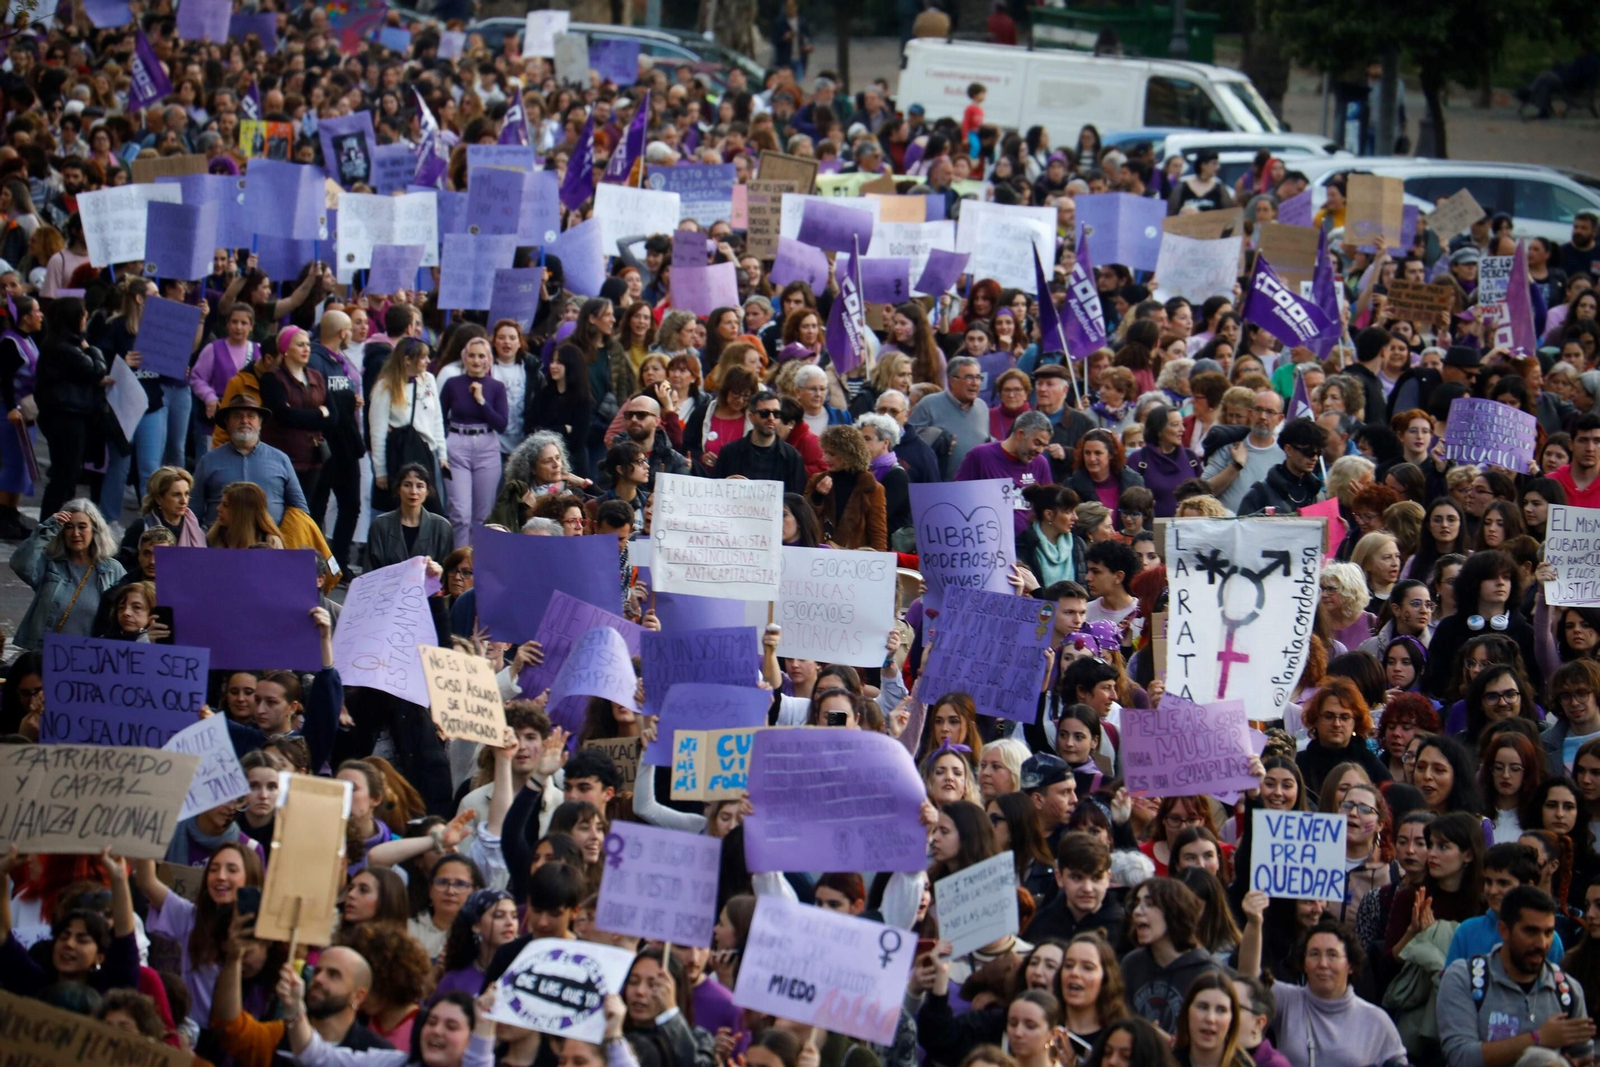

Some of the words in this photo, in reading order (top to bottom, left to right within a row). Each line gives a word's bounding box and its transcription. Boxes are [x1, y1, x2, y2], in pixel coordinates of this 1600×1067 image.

[660, 479, 676, 495] LA
[681, 480, 723, 499] LUCHA
[725, 482, 777, 500] FEMINISTA
[661, 500, 675, 515] ES
[1551, 507, 1572, 532] EL
[925, 520, 999, 548] LIBRES
[1547, 537, 1590, 552] CUBATA
[810, 557, 886, 582] SOMOS
[923, 550, 1007, 570] PODEROSAS
[1546, 555, 1564, 566] NOS
[1566, 567, 1595, 579] ELLOS
[782, 601, 855, 625] SOMOS
[384, 585, 424, 691] ESTÁBAMOS
[694, 633, 753, 662] SISTEMA
[51, 636, 145, 675] DÉJAME
[156, 653, 200, 681] SER
[428, 652, 444, 670] NO
[448, 655, 460, 672] ES
[464, 657, 478, 675] UN
[54, 680, 106, 704] OTRA
[109, 684, 157, 710] COSA
[162, 689, 204, 713] QUE
[435, 676, 462, 693] CASO
[447, 698, 459, 711] SE
[464, 702, 494, 720] LLAMA
[1123, 705, 1213, 737] PELEAR
[41, 713, 71, 740] NO
[78, 716, 115, 747] SEA
[118, 720, 144, 747] UN
[440, 711, 498, 740] PATRIARCADO
[1155, 726, 1245, 765] MUJER
[8, 746, 173, 776] PATRIARCADO
[1128, 775, 1150, 791] ES
[1172, 756, 1251, 788] CUMPLIDO
[16, 775, 28, 794] Y
[50, 771, 153, 800] CAPITAL
[78, 803, 169, 846] COLONIAL
[1265, 812, 1343, 843] VEÑEN
[1270, 843, 1317, 864] PRA
[1254, 864, 1345, 899] QUEDAR
[767, 973, 818, 1004] MIEDO
